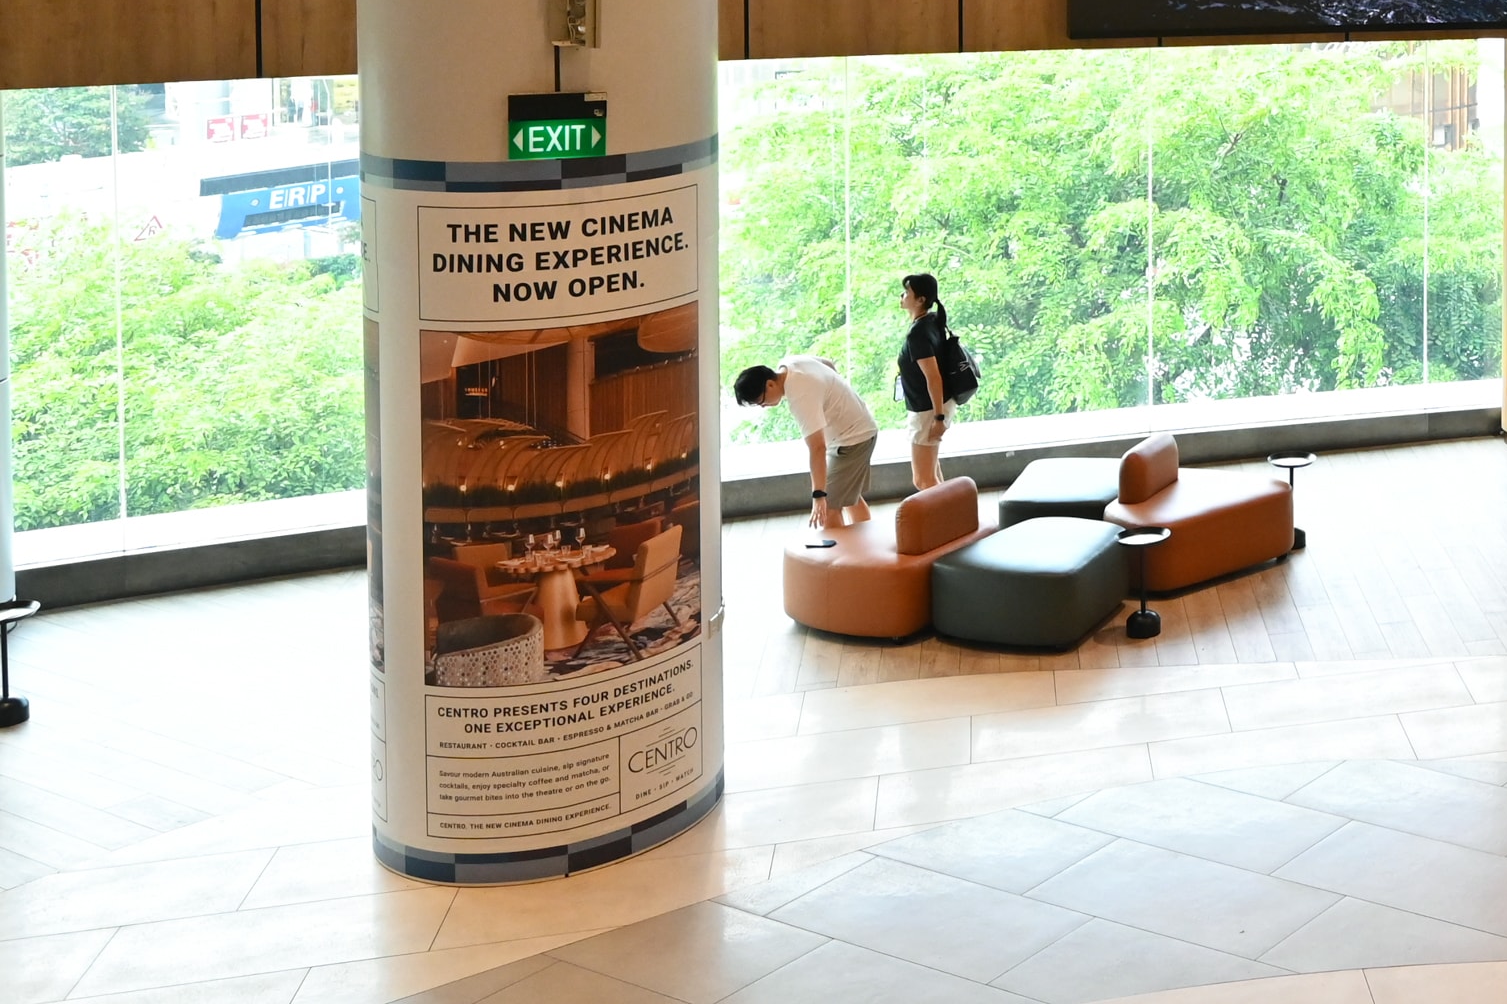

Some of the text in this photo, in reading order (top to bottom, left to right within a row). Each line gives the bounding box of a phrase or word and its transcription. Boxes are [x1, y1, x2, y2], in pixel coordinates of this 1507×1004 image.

[528, 124, 586, 152] EXIT
[447, 206, 674, 243] THE NEW CINEMA
[433, 232, 689, 273] DINING EXPERIENCE.
[493, 270, 645, 303] NOW OPEN.
[437, 659, 694, 718] CENTRO PRESENTS FOUR DESTINATIONS.
[464, 683, 675, 733] ONE EXCEPTIONAL EXPERIENCE.
[495, 739, 535, 748] COCKTAIL
[538, 737, 555, 745] BAR
[563, 726, 604, 741] ESPRESSO
[614, 714, 644, 729] MATCHA
[646, 708, 659, 718] BAR
[492, 769, 529, 777] Australian
[531, 765, 560, 774] cuisine,
[562, 763, 574, 772] sip
[576, 753, 609, 768] signature
[628, 726, 698, 774] CENTRO
[455, 794, 483, 802] gourmet
[485, 793, 503, 801] bites
[536, 787, 563, 797] theatre
[586, 779, 598, 787] the
[600, 776, 611, 784] go.
[472, 783, 490, 791] enjoy
[493, 781, 526, 791] specialty
[528, 777, 553, 786] coffee
[571, 768, 600, 779] matcha,
[636, 789, 651, 800] DINE
[659, 781, 669, 790] SIP
[504, 820, 534, 828] CINEMA
[536, 815, 563, 825] DINING
[565, 803, 612, 821] EXPERIENCE.
